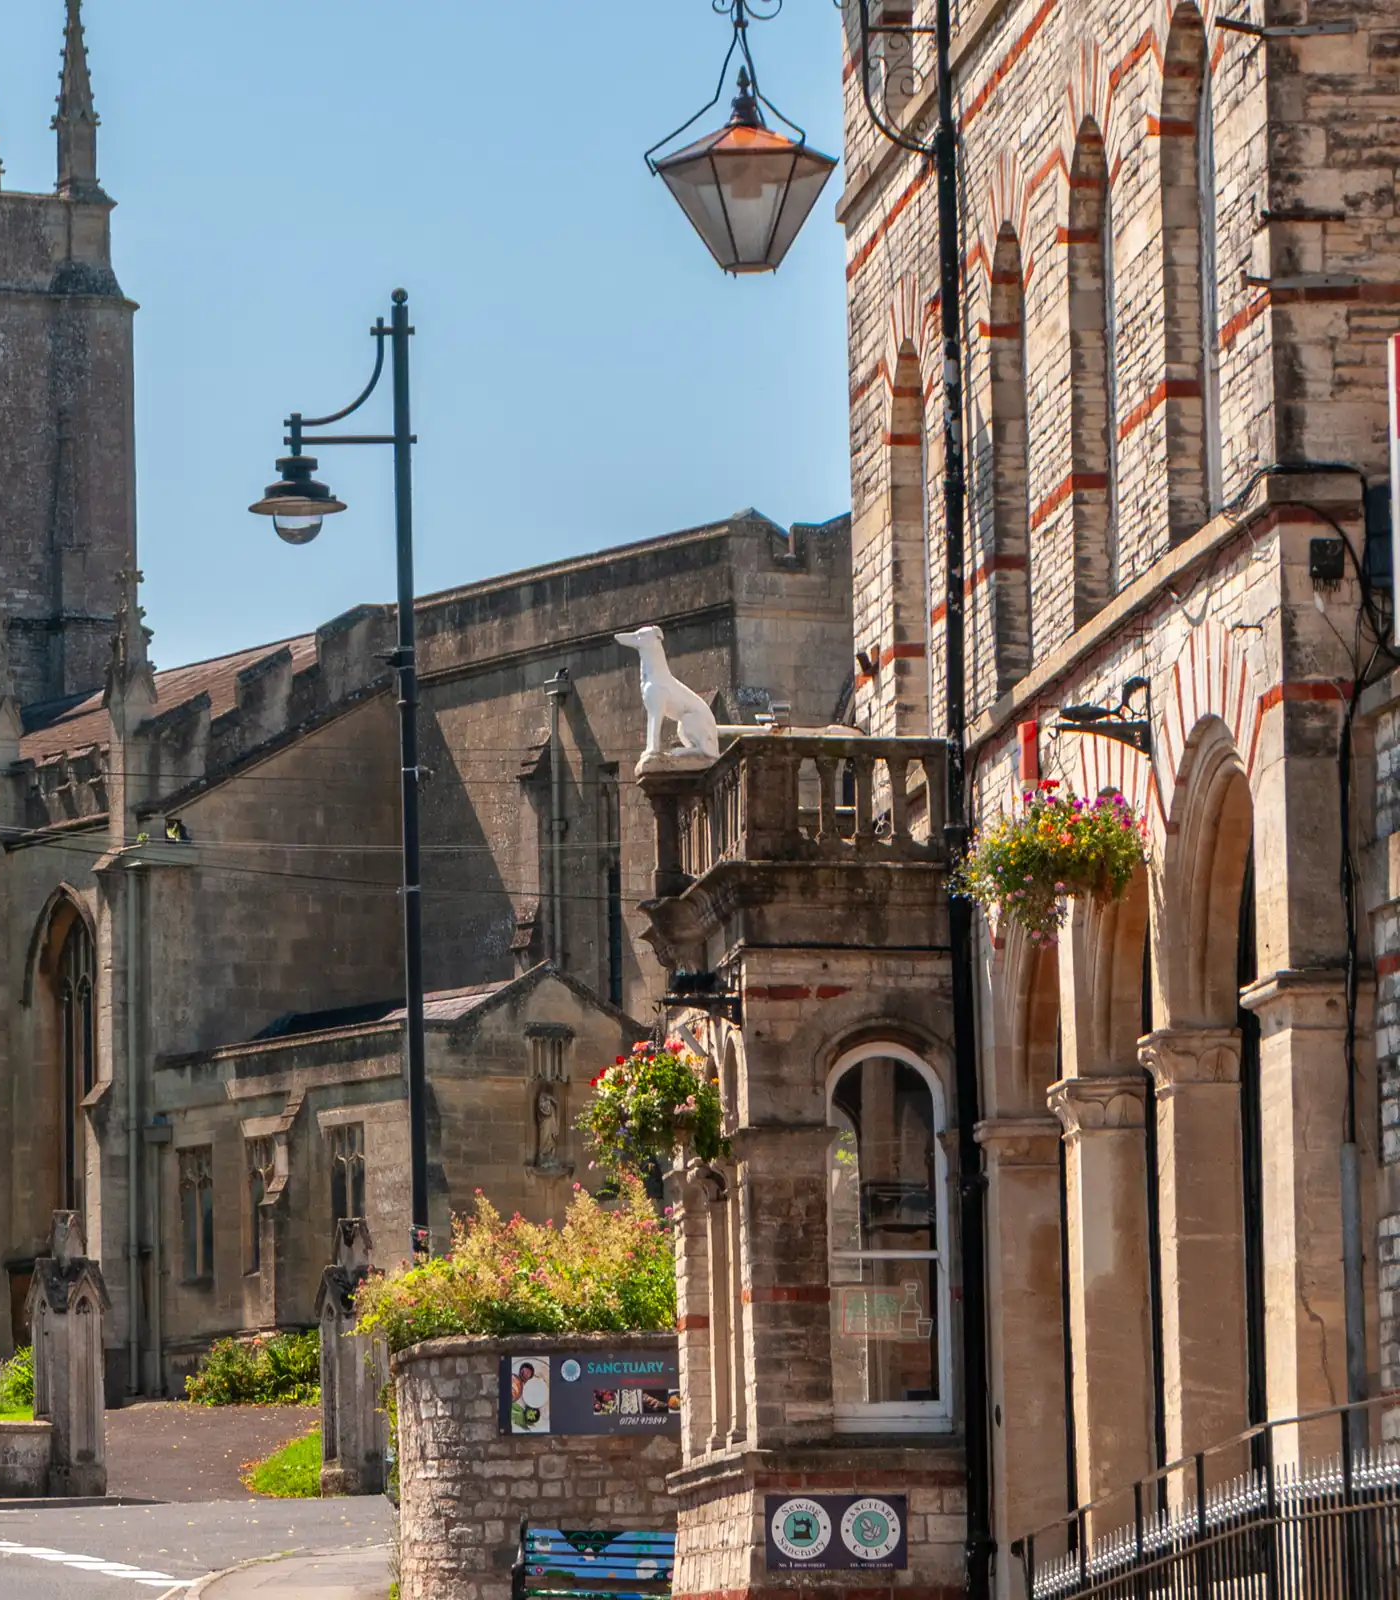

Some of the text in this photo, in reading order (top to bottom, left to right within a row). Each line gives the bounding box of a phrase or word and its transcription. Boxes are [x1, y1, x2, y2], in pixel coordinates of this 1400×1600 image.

[587, 1360, 664, 1374] SANCTUARY
[781, 1503, 822, 1517] Sewing
[847, 1502, 896, 1523] SANCTUARY
[778, 1537, 826, 1557] Sanctuary
[853, 1543, 892, 1557] CAFE
